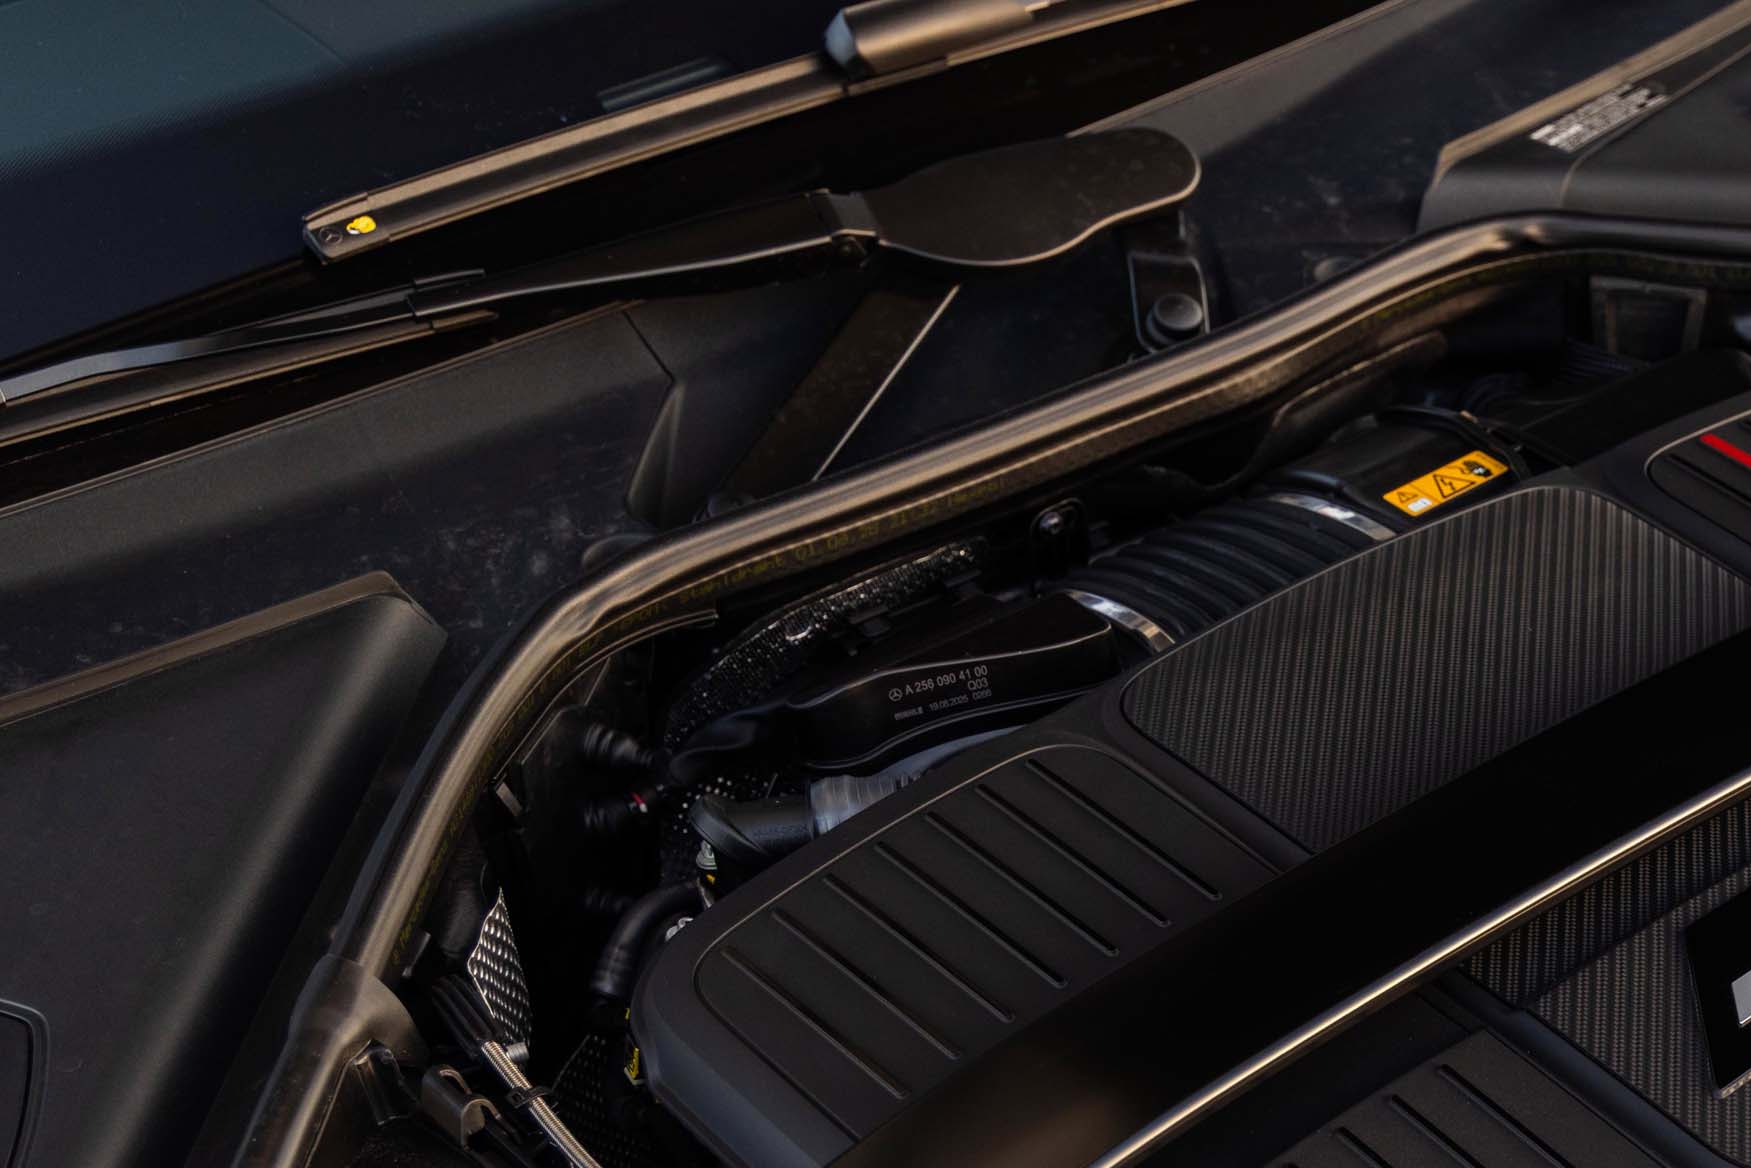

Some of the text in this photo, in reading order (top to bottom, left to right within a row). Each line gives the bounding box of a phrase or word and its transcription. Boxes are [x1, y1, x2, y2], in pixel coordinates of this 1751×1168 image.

[905, 665, 988, 696] A 256 090 41 00
[967, 677, 988, 690] Q03
